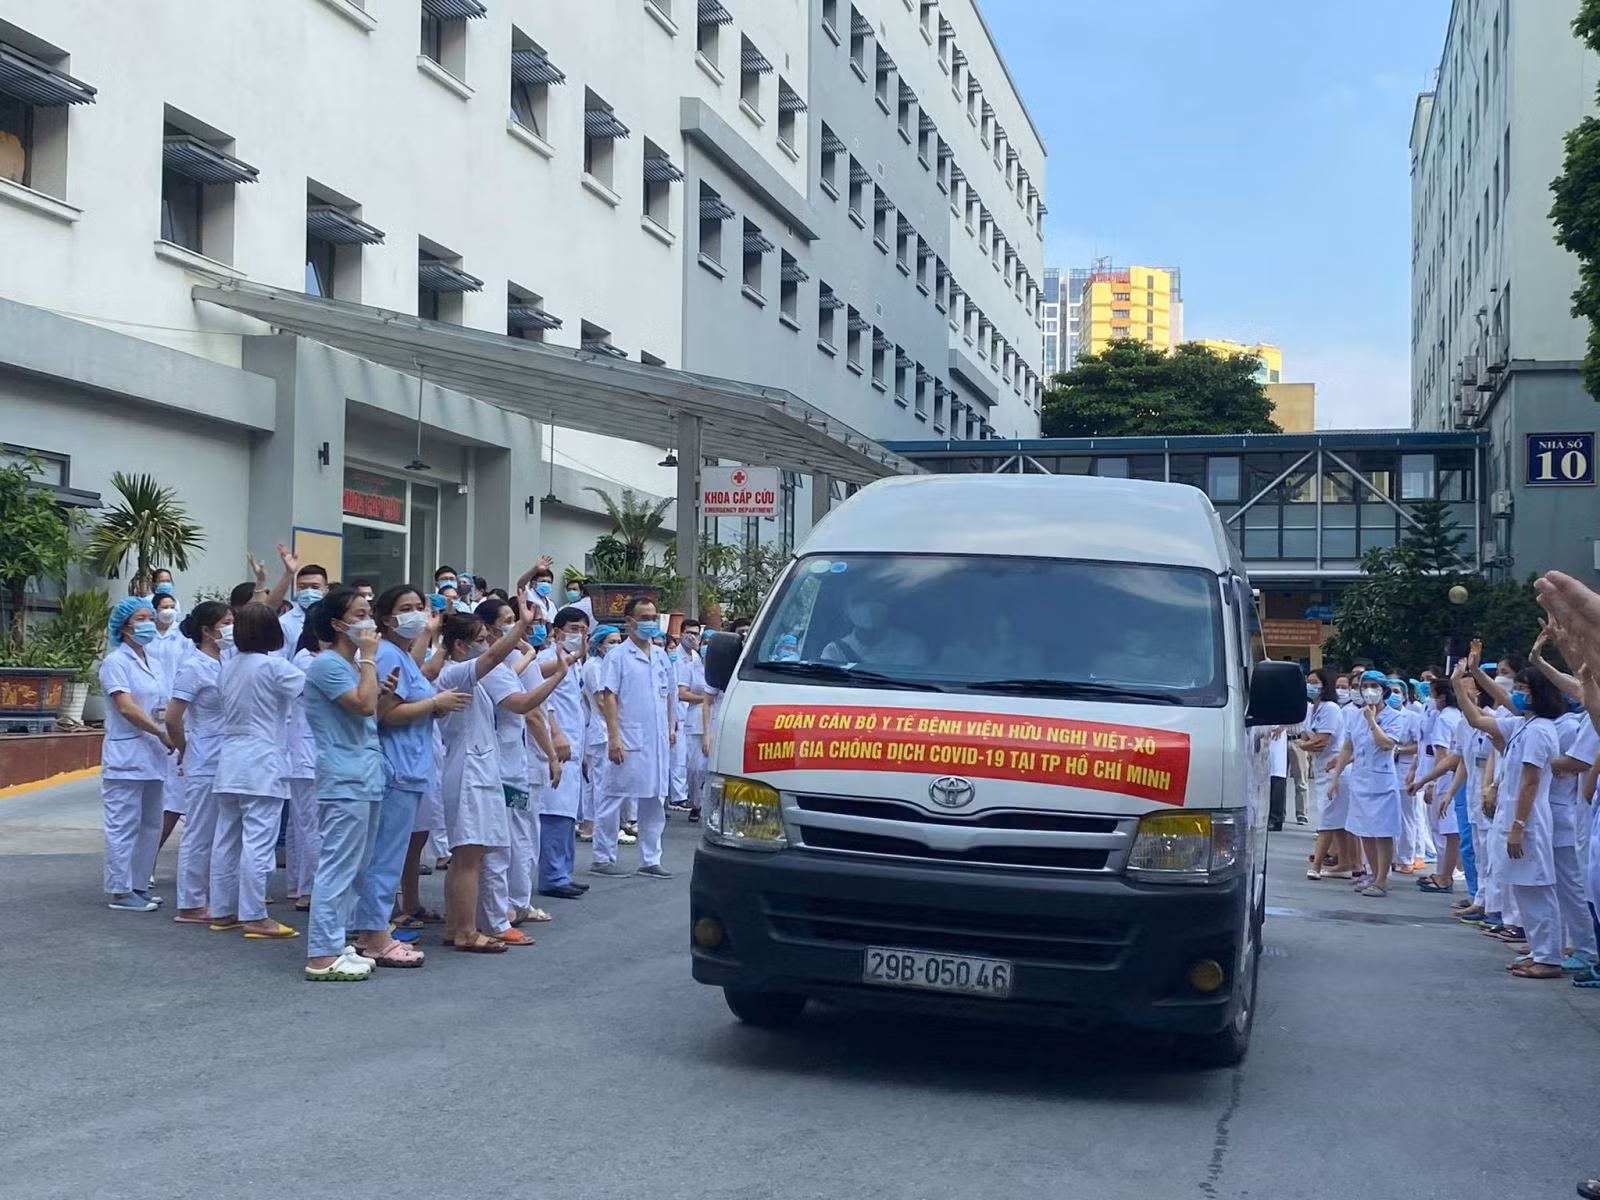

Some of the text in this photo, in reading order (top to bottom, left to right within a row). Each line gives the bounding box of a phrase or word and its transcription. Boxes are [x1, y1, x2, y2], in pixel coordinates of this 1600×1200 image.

[1535, 450, 1587, 480] 10
[704, 487, 775, 505] KHOA CẤP CỨU
[774, 711, 1156, 755] ĐOÀN CÁN BỘ Y TẾ BỆNH VIỆN HỮU NGHỊ VIỆT-XÔ
[757, 735, 1171, 790] THAM GIA CHỐNG DỊCH COVID-19 TẠI TP HỒ CHÍ MINH
[870, 952, 1007, 993] 29B-050.46
